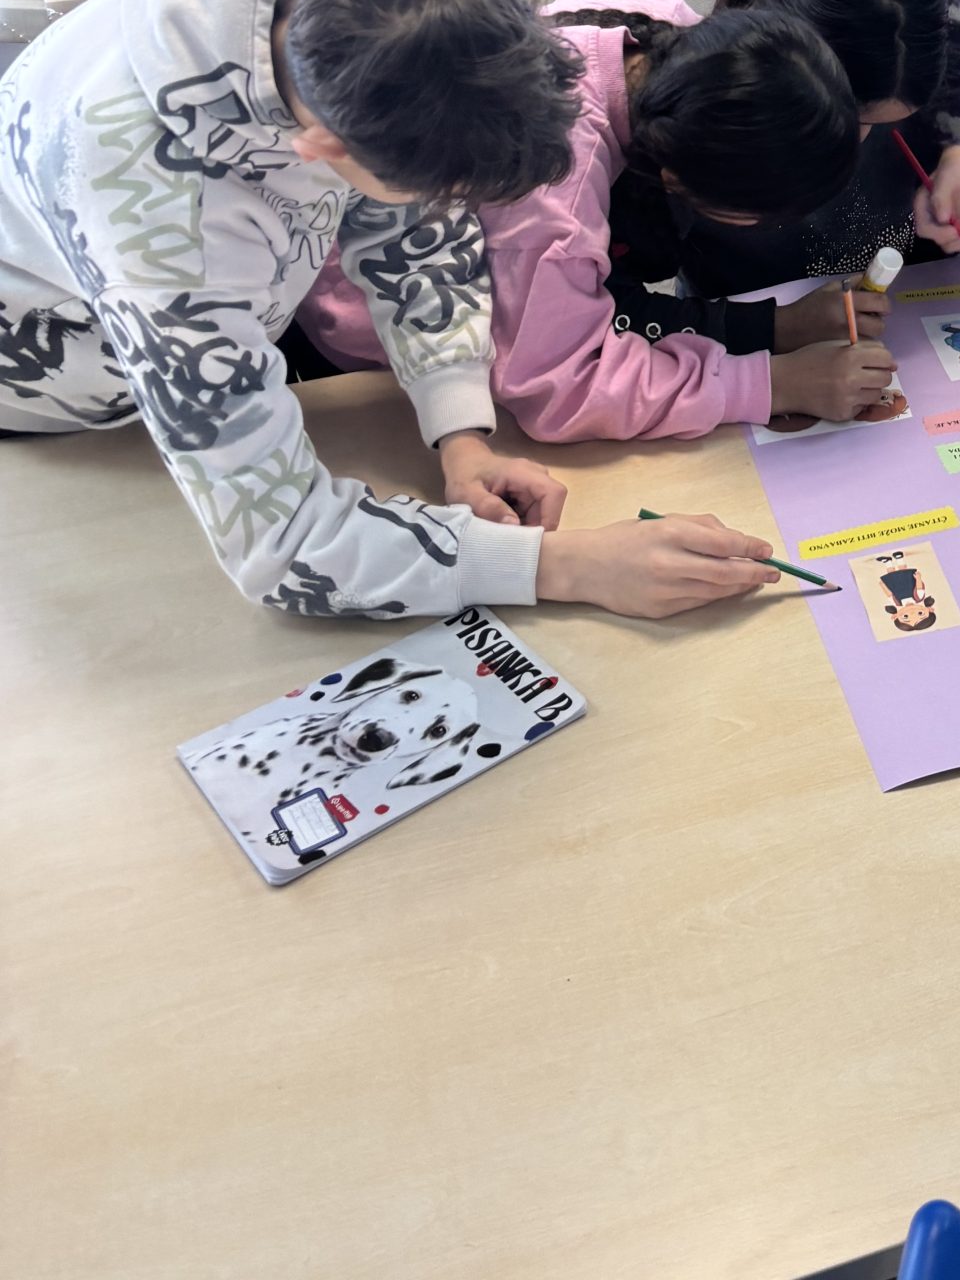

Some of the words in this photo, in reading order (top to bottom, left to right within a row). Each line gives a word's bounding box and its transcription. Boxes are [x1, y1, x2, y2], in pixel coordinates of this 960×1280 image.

[908, 516, 947, 530] ČITANJE
[857, 532, 876, 541] BITI
[878, 525, 906, 538] MOŽE
[809, 537, 854, 552] ZABAVNO
[444, 608, 553, 703] PISANKA
[534, 693, 572, 721] B
